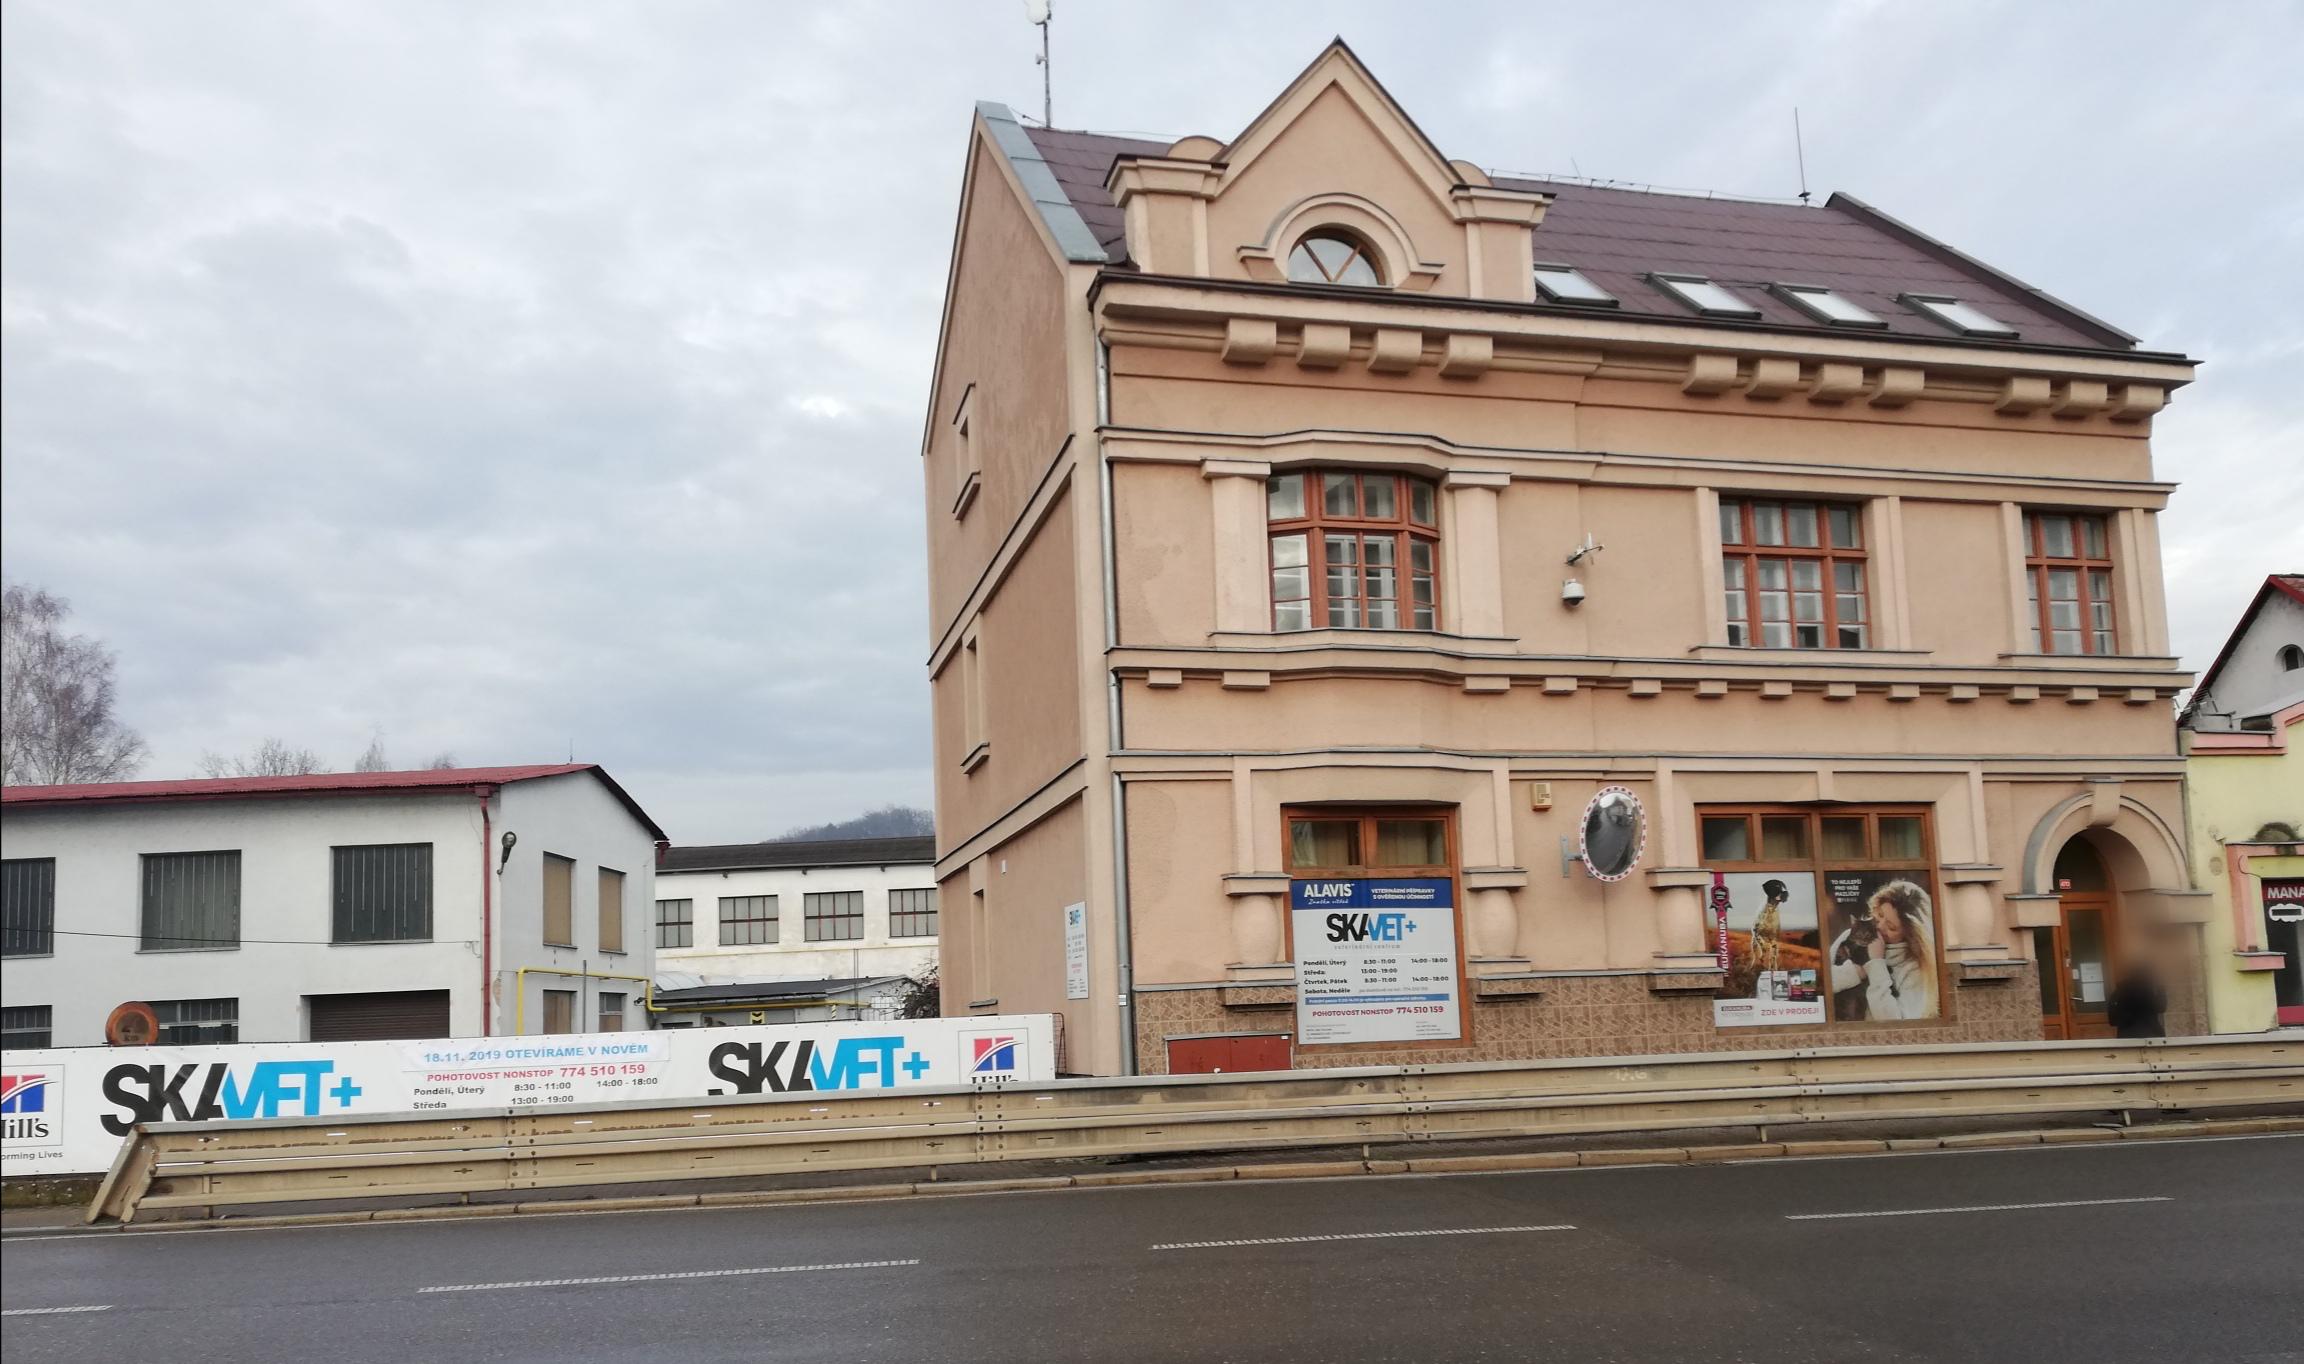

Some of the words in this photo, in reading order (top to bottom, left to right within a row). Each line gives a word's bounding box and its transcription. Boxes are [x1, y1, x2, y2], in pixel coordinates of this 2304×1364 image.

[1303, 883, 1353, 898] ALAVIS
[424, 1052, 465, 1062] 18.11.
[469, 1050, 500, 1060] 2019
[588, 1046, 597, 1055] V
[602, 1044, 648, 1054] NOVÉM
[426, 1072, 500, 1082] POHOTOVOST
[503, 1069, 554, 1079] NONSTOP
[560, 1067, 586, 1077] 774
[590, 1066, 616, 1076] 510
[620, 1064, 646, 1074] 159
[514, 1084, 535, 1092] 8:30
[546, 1082, 572, 1090] 11:00
[597, 1080, 623, 1088] 14:00
[632, 1078, 658, 1086] 18:00
[414, 1087, 454, 1096] Pondělí,
[457, 1085, 486, 1095] Úterý
[512, 1096, 538, 1104] 13:00
[547, 1095, 574, 1104] 19:00
[413, 1100, 447, 1110] Středa
[38, 1151, 64, 1159] Lives
